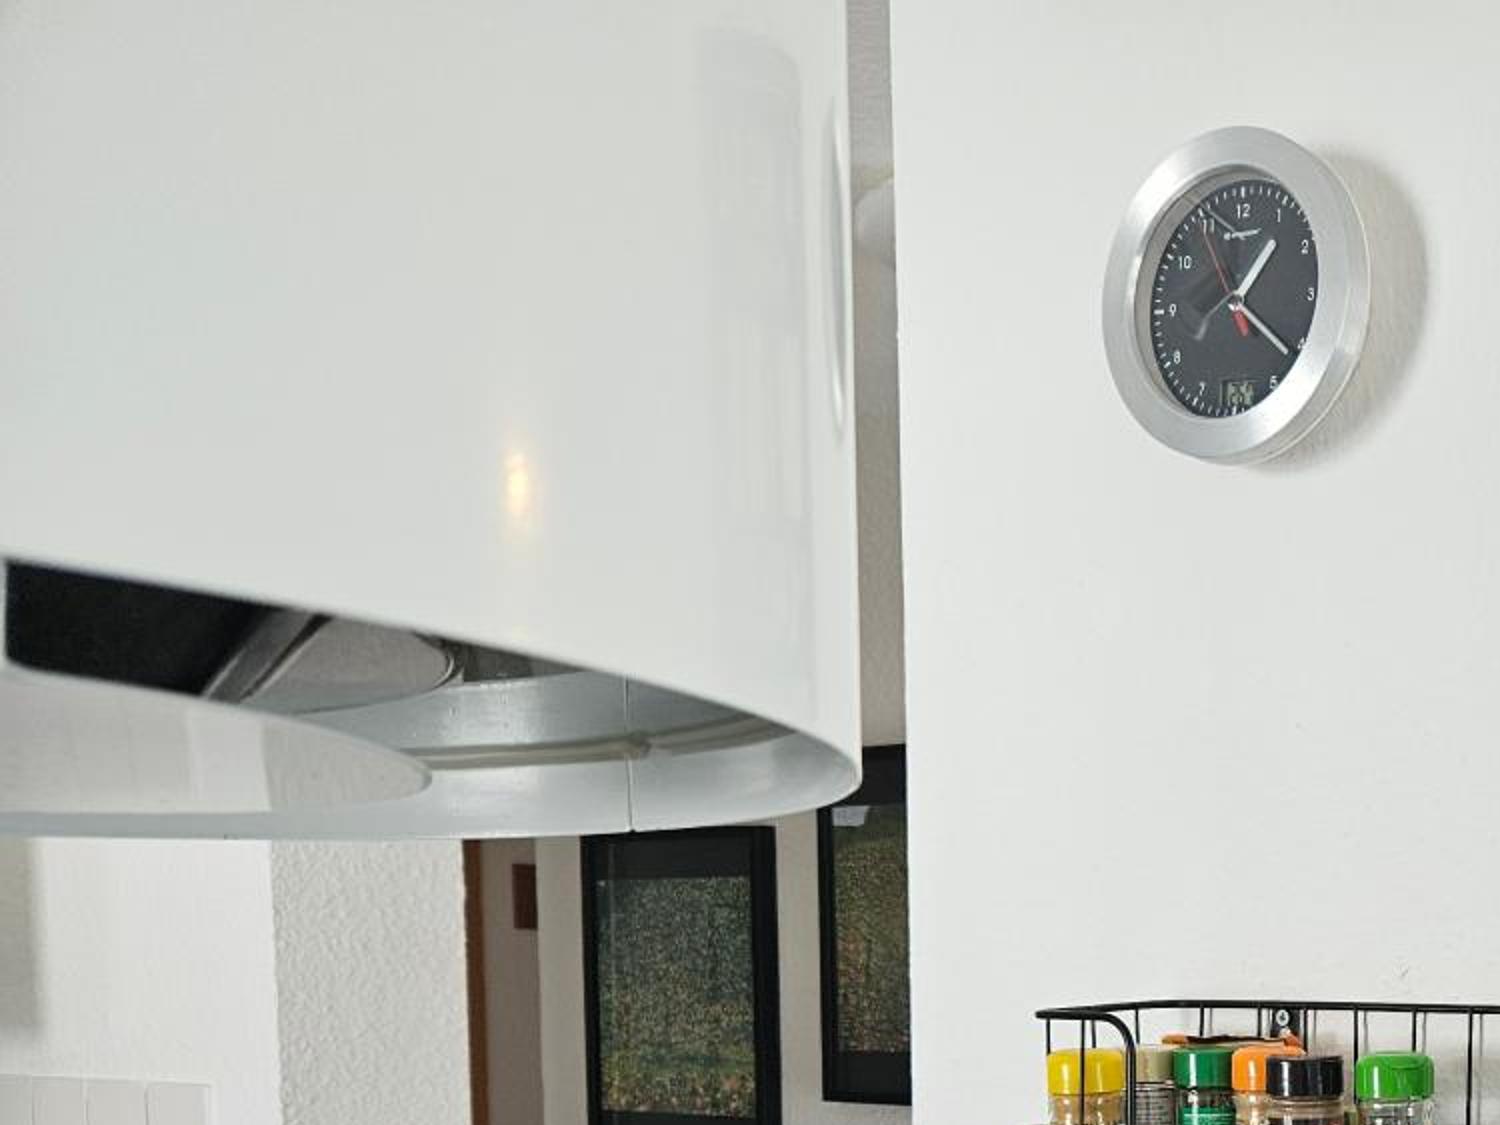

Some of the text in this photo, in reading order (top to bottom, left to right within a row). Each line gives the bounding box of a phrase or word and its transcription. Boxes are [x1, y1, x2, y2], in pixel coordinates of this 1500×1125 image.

[1236, 204, 1250, 218] 12
[1276, 208, 1282, 223] 1
[1301, 240, 1309, 255] 2
[1178, 255, 1192, 270] 10
[1306, 288, 1315, 301] 3
[1168, 304, 1177, 317] 9
[1173, 351, 1181, 364] 8
[1269, 376, 1278, 390] 5
